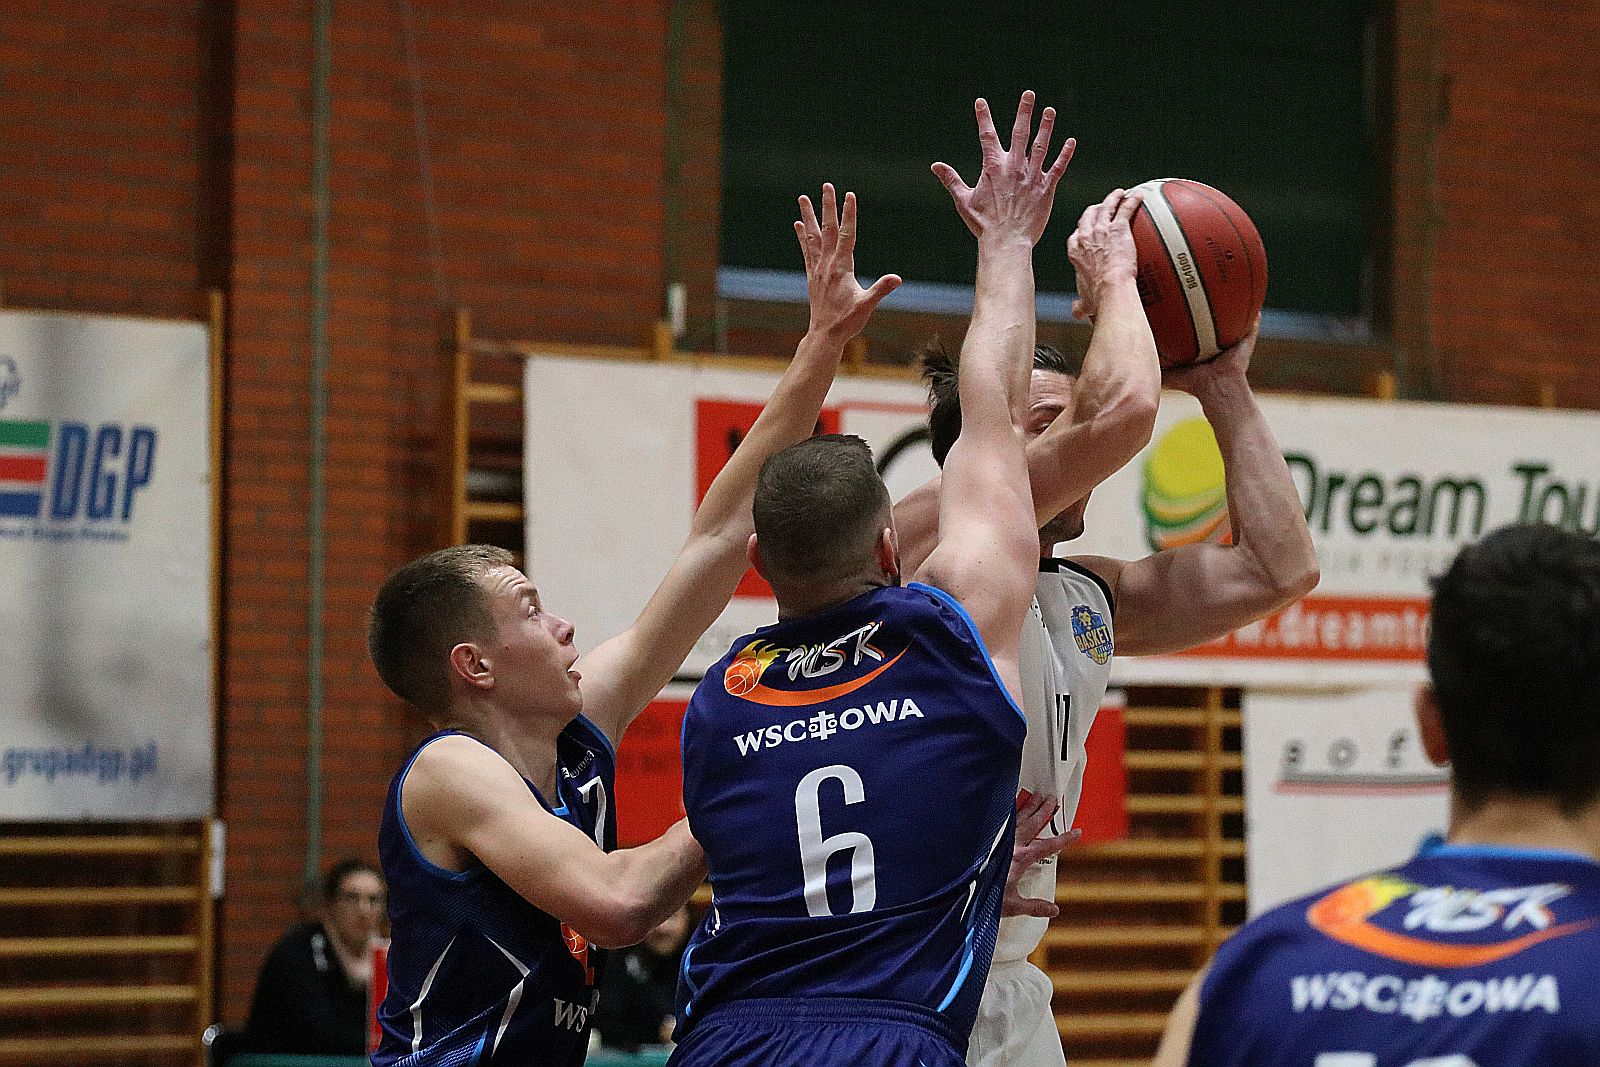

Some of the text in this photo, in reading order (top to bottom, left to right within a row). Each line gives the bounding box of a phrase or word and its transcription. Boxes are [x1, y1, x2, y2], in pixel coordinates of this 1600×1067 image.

[50, 421, 158, 524] DGP
[1282, 449, 1486, 536] Dream
[1075, 625, 1110, 651] BASKET
[795, 765, 876, 917] 6
